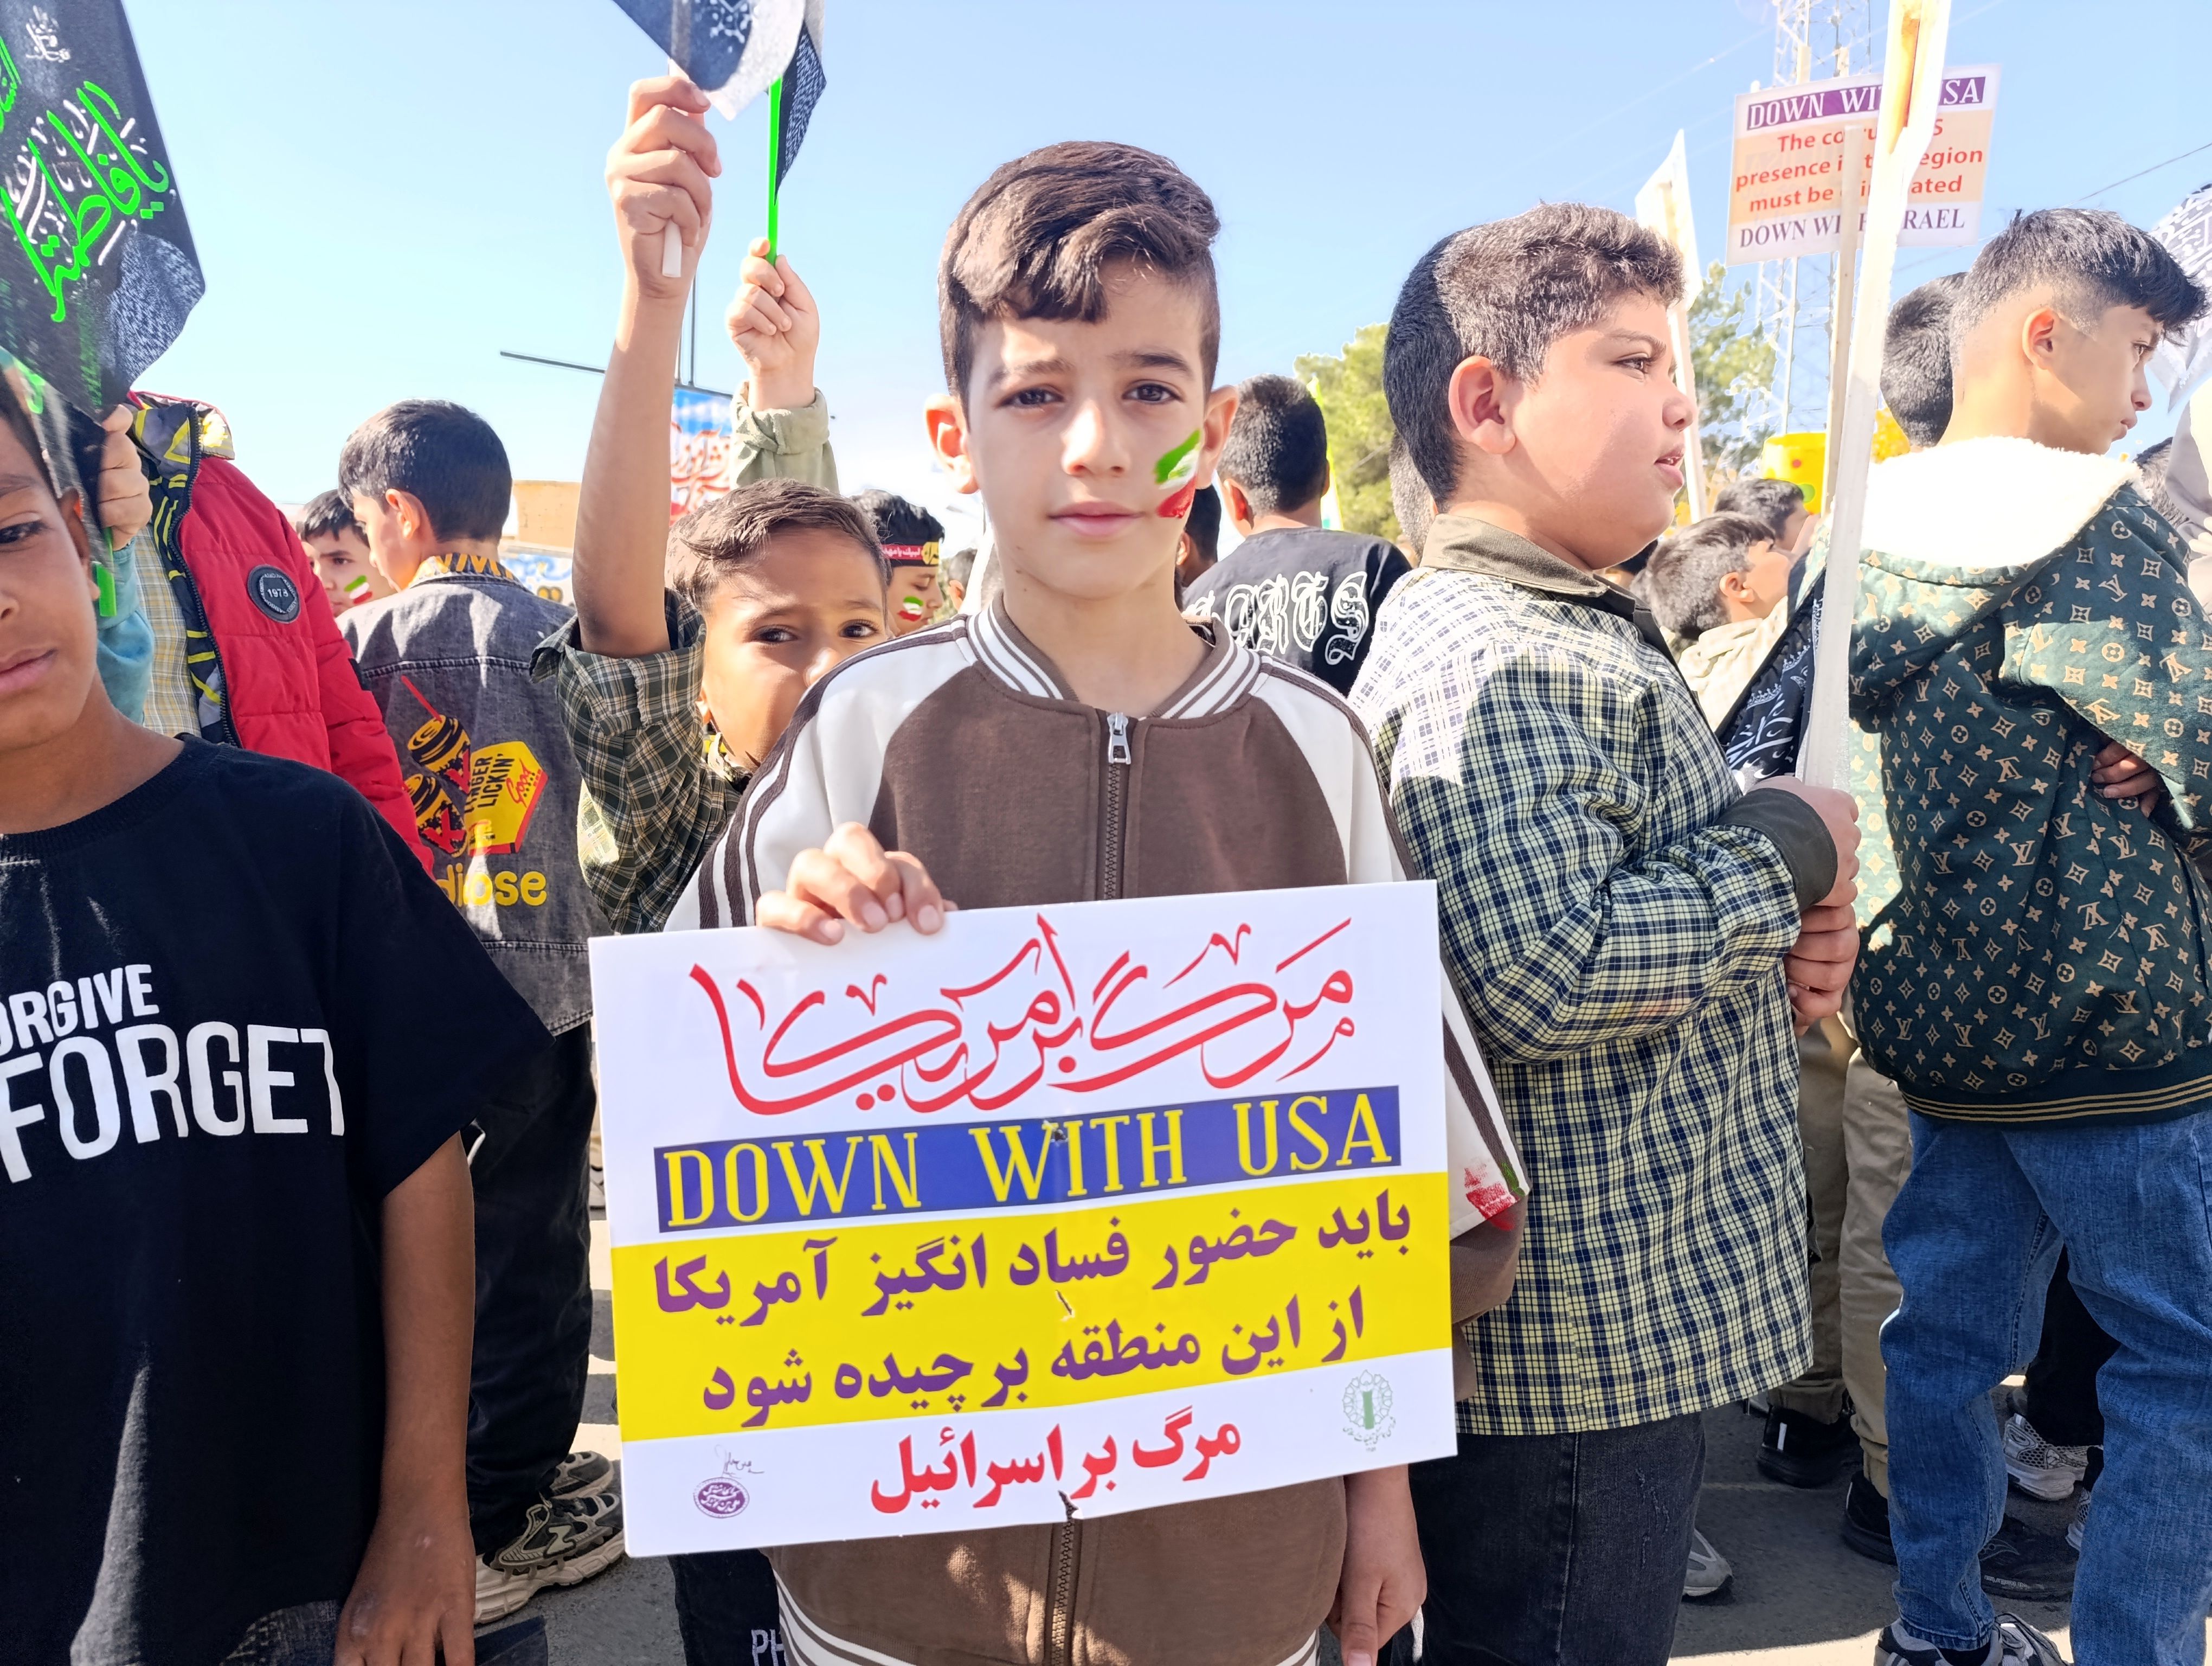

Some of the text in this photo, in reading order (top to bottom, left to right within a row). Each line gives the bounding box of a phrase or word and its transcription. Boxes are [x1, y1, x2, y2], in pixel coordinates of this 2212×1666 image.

[1748, 79, 1980, 130] DOWN WI SA
[1777, 132, 1815, 152] The
[1735, 159, 1830, 192] presence
[1920, 147, 1983, 169] egion
[1749, 190, 1801, 212] must
[1808, 187, 1834, 202] be
[1740, 220, 1806, 248] DOWN
[1903, 208, 1965, 229] RAEL
[0, 1021, 345, 1183] FORGET
[664, 1092, 1392, 1227] DOWN WITH USA
[654, 1190, 1411, 1327] باید حضور فساد انگیز آمریکا
[1051, 1319, 1200, 1381] منطقه
[1221, 1293, 1301, 1375] این
[1321, 1284, 1365, 1362] از
[703, 1348, 812, 1427] شود
[1132, 1405, 1242, 1482] مرگ
